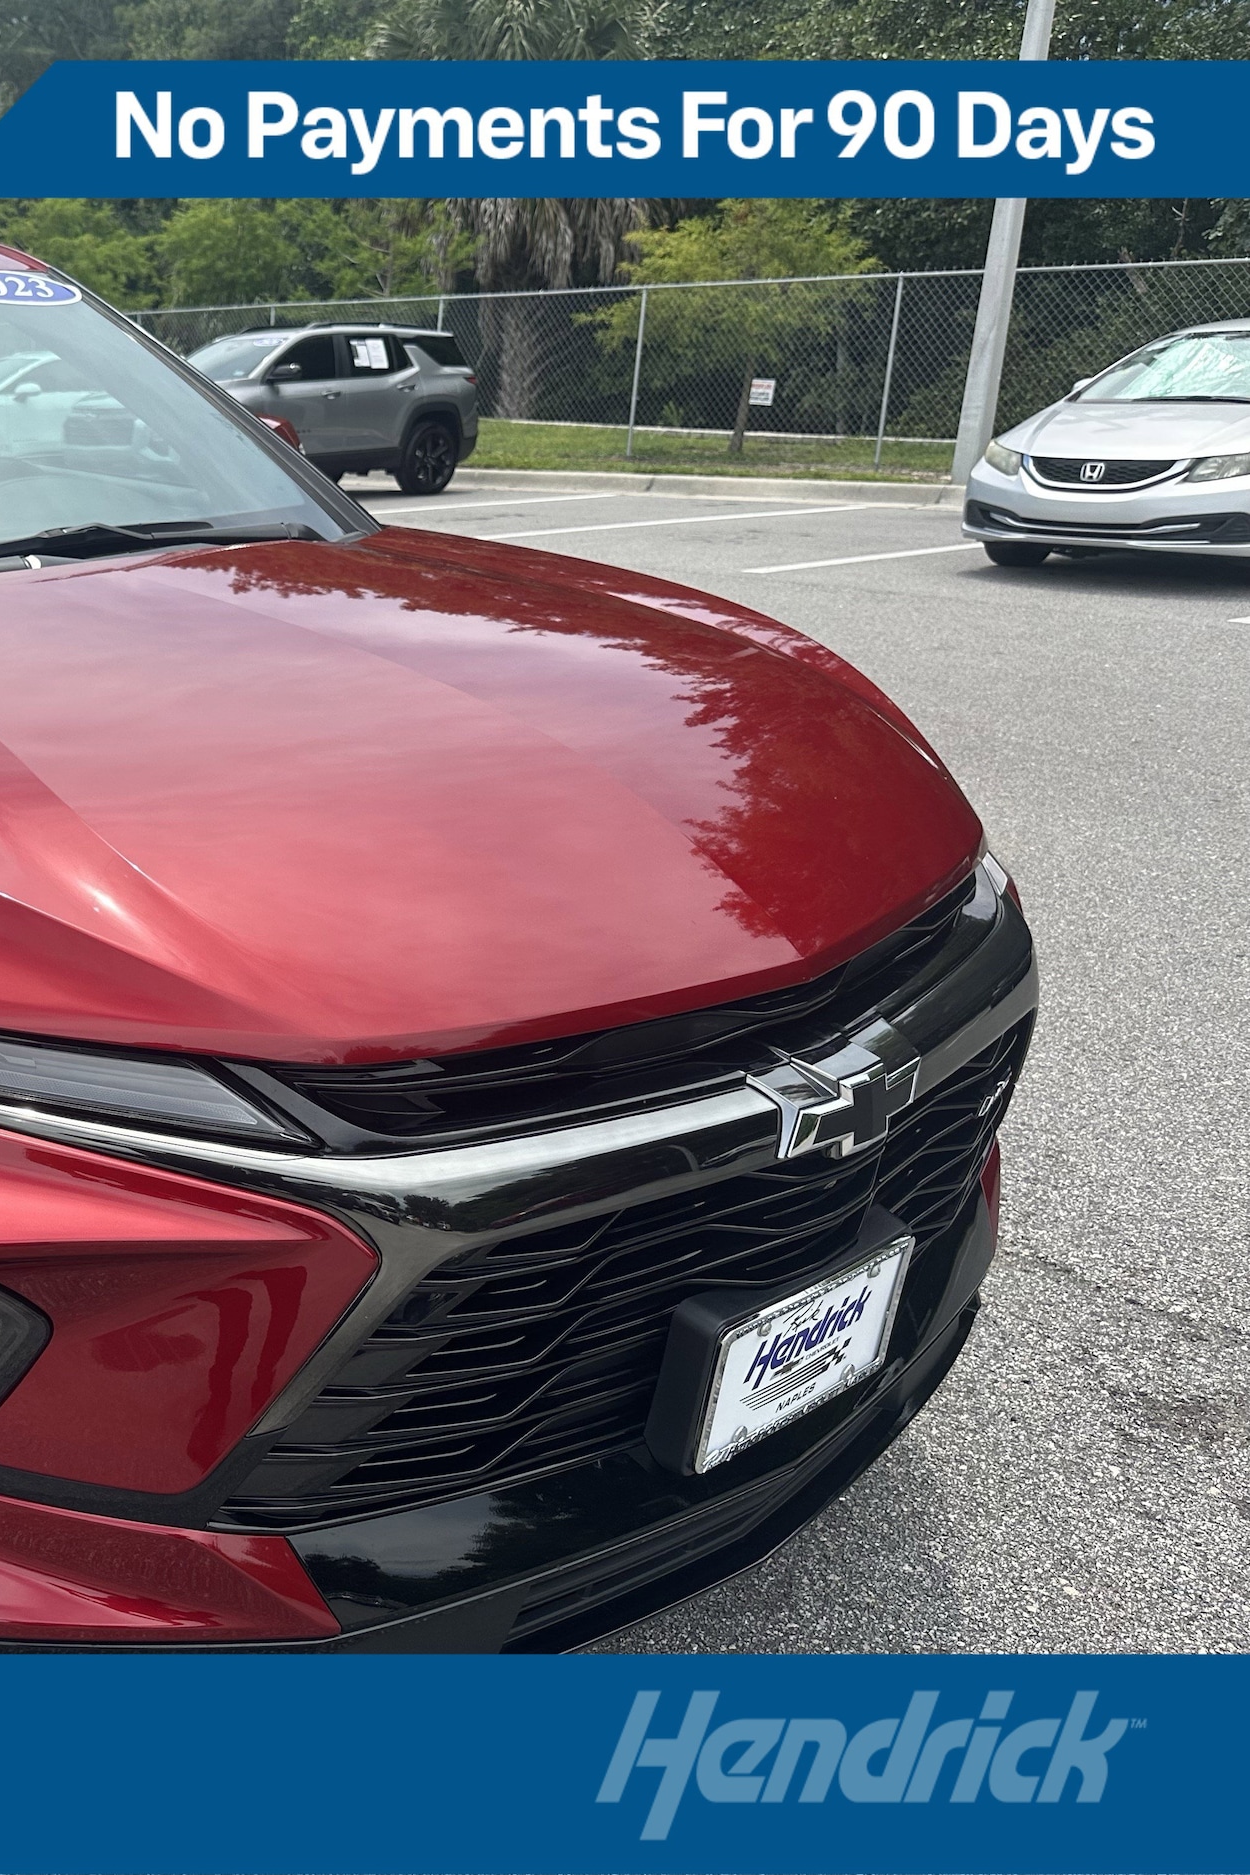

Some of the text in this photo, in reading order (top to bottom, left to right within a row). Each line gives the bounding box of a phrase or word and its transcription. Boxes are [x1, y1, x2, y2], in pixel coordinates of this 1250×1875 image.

[743, 1285, 872, 1391] Hendrick
[783, 1299, 824, 1338] Rick
[775, 1382, 817, 1413] NAPLES
